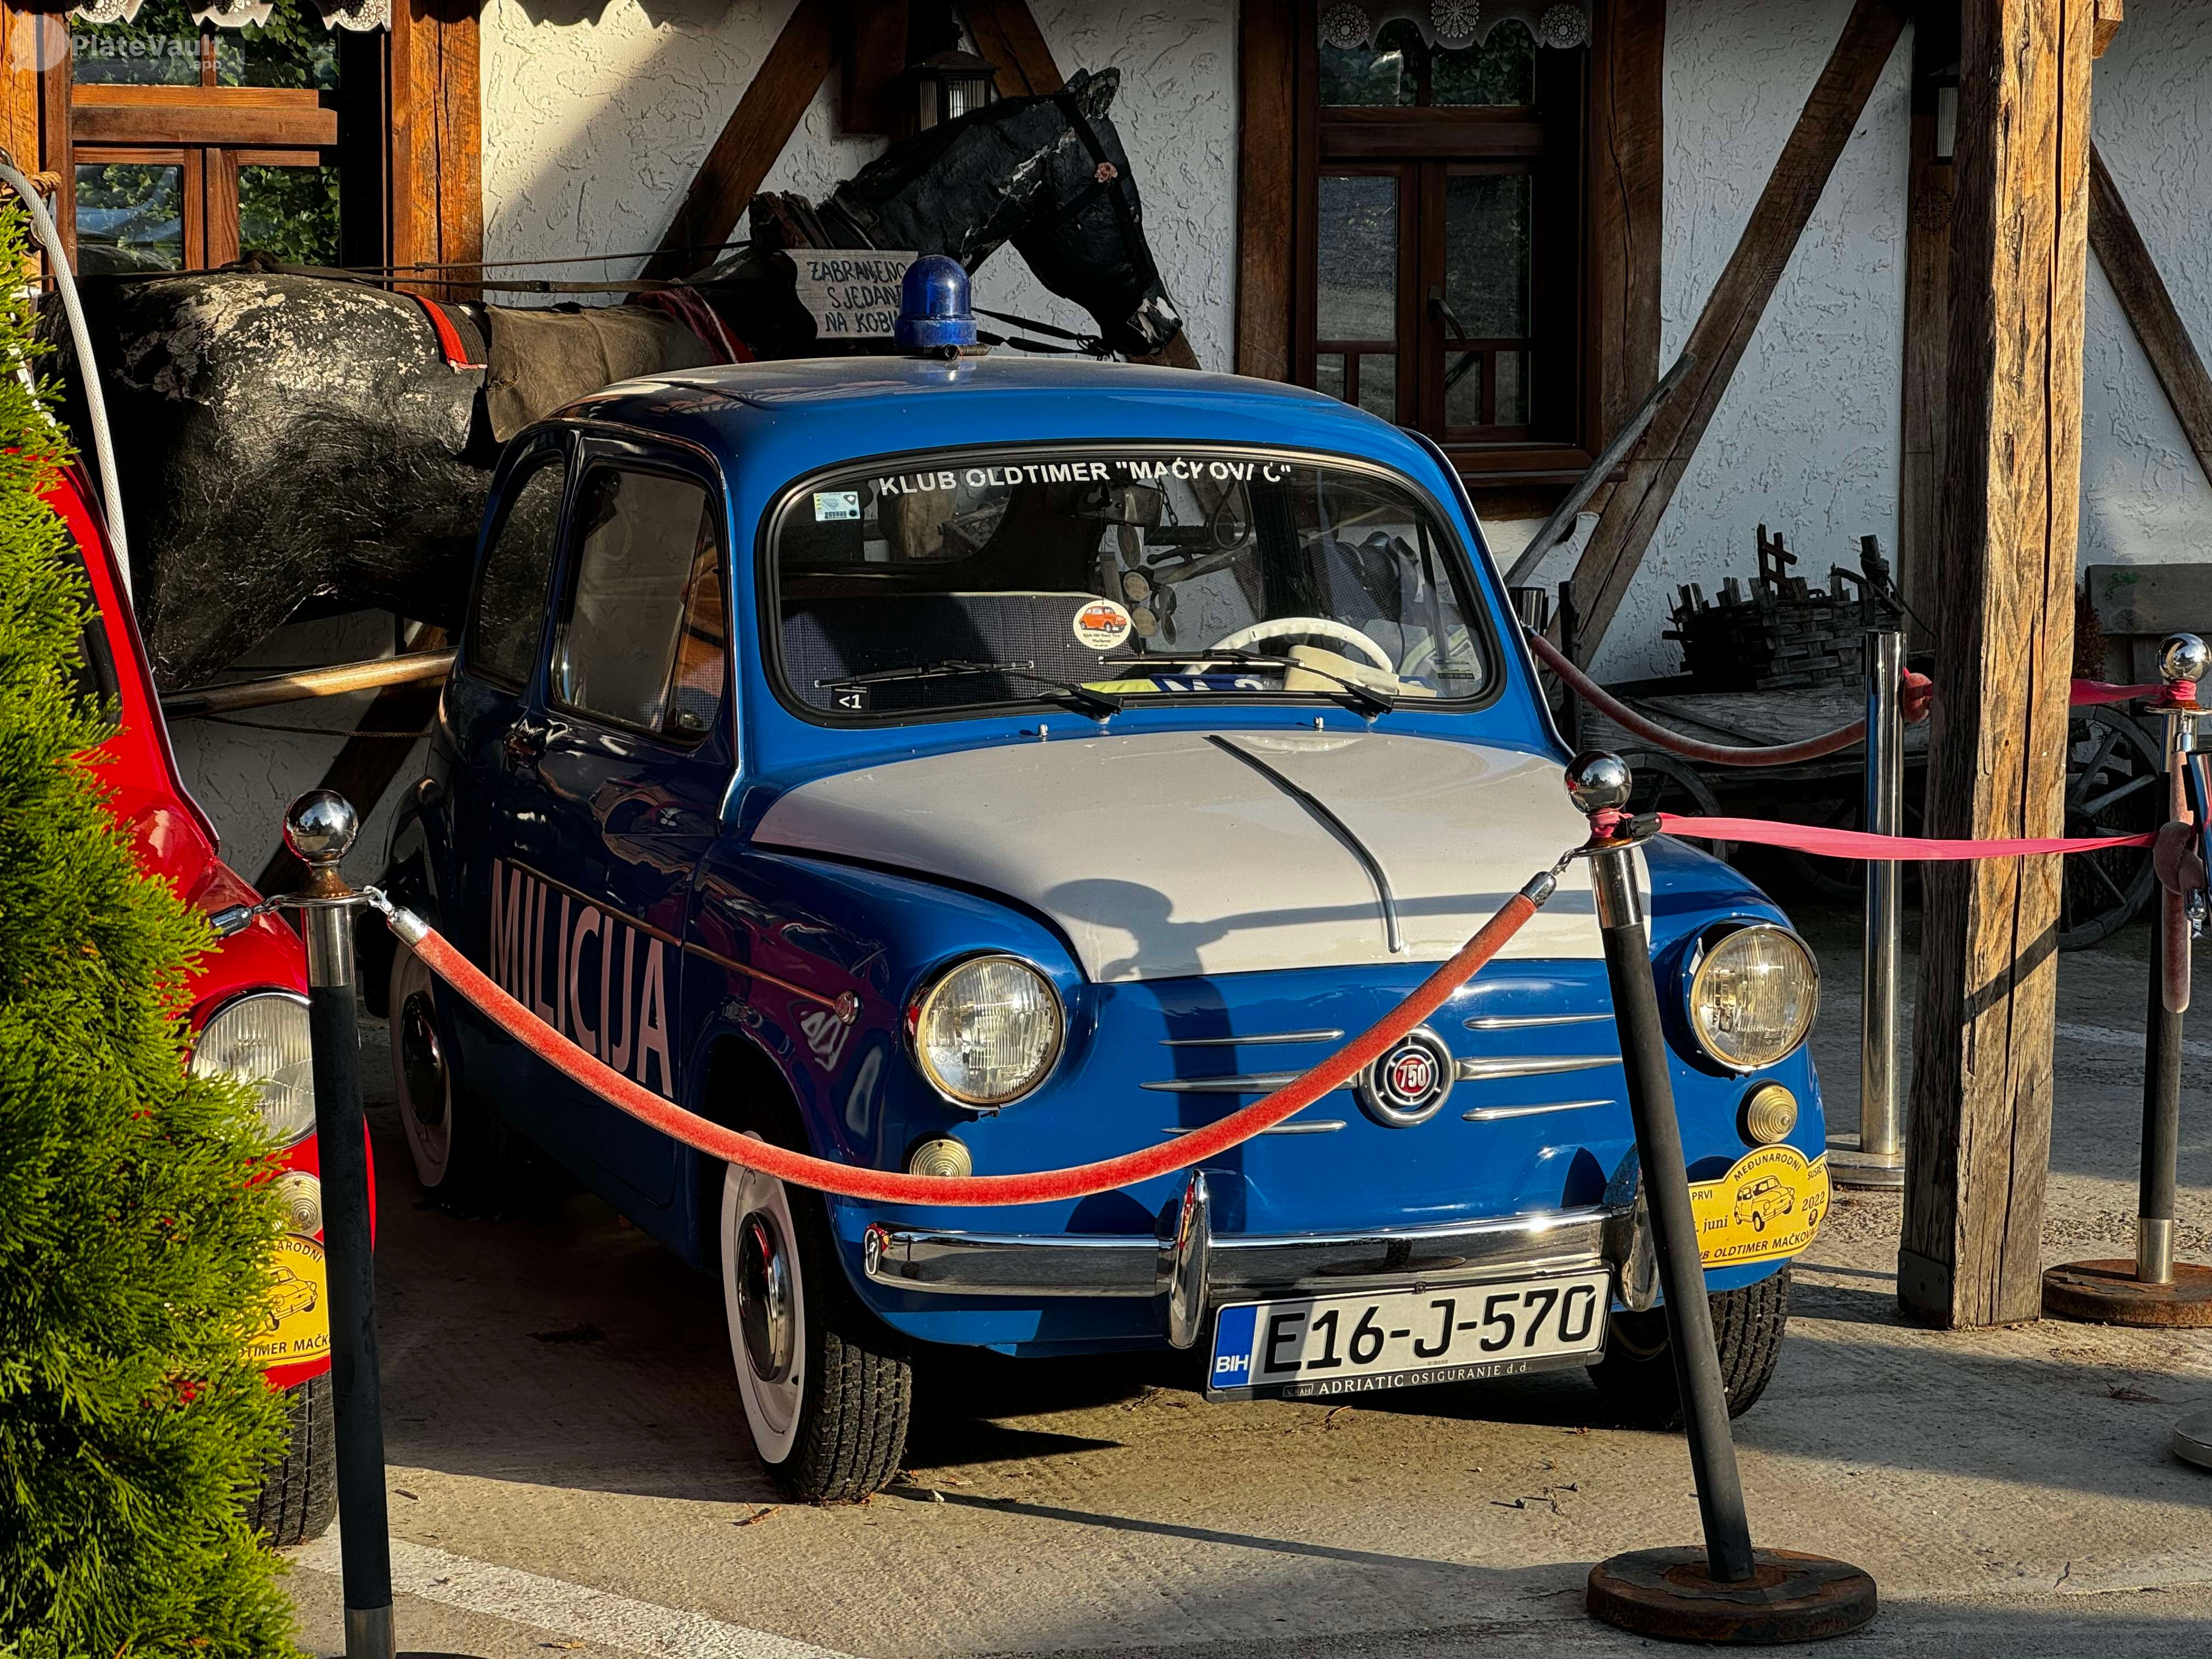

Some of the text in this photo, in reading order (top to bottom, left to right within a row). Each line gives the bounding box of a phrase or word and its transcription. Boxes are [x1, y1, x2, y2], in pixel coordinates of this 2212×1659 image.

[825, 311, 898, 333] NA KOBI
[878, 471, 957, 496] KLUB
[966, 461, 1110, 487] OLDTIMER
[490, 857, 674, 1099] MILICIJA
[1399, 1064, 1426, 1088] 750
[1734, 1153, 1802, 1182] MEĐUNARODNI
[1692, 1189, 1713, 1201] PRVI
[1802, 1190, 1825, 1212] 2022
[1702, 1215, 1728, 1234] juni
[277, 1242, 323, 1263] ARODNI
[1713, 1240, 1768, 1257] OLDTIMER
[1263, 1284, 1596, 1374] E16-J-570
[241, 1333, 329, 1358] TIMER MAČK
[1215, 1354, 1249, 1373] BIH
[1318, 1374, 1404, 1395] ADRIATIC
[1412, 1365, 1501, 1385] OSIGURANJE
